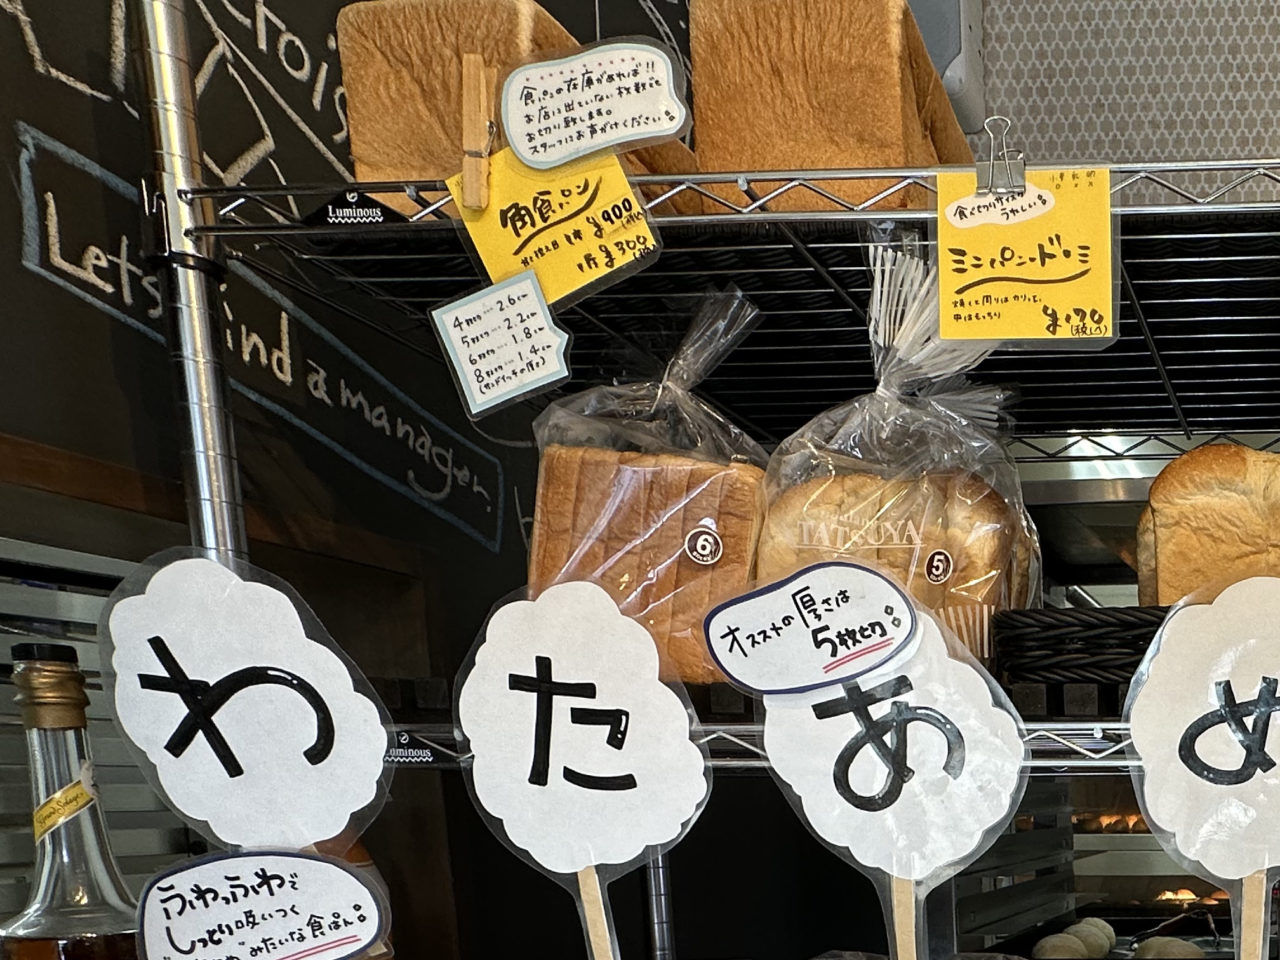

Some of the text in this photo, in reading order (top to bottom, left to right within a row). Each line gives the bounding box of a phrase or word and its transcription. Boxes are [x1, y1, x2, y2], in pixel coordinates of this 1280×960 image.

[327, 204, 383, 218] Luminous
[500, 177, 590, 238] 角食パン
[696, 533, 714, 555] 6
[932, 554, 945, 575] 5
[720, 585, 850, 658] オススメの厚さは
[811, 620, 887, 659] 5枚切
[137, 635, 335, 778] わ
[508, 655, 638, 791] た
[810, 676, 966, 813] あ
